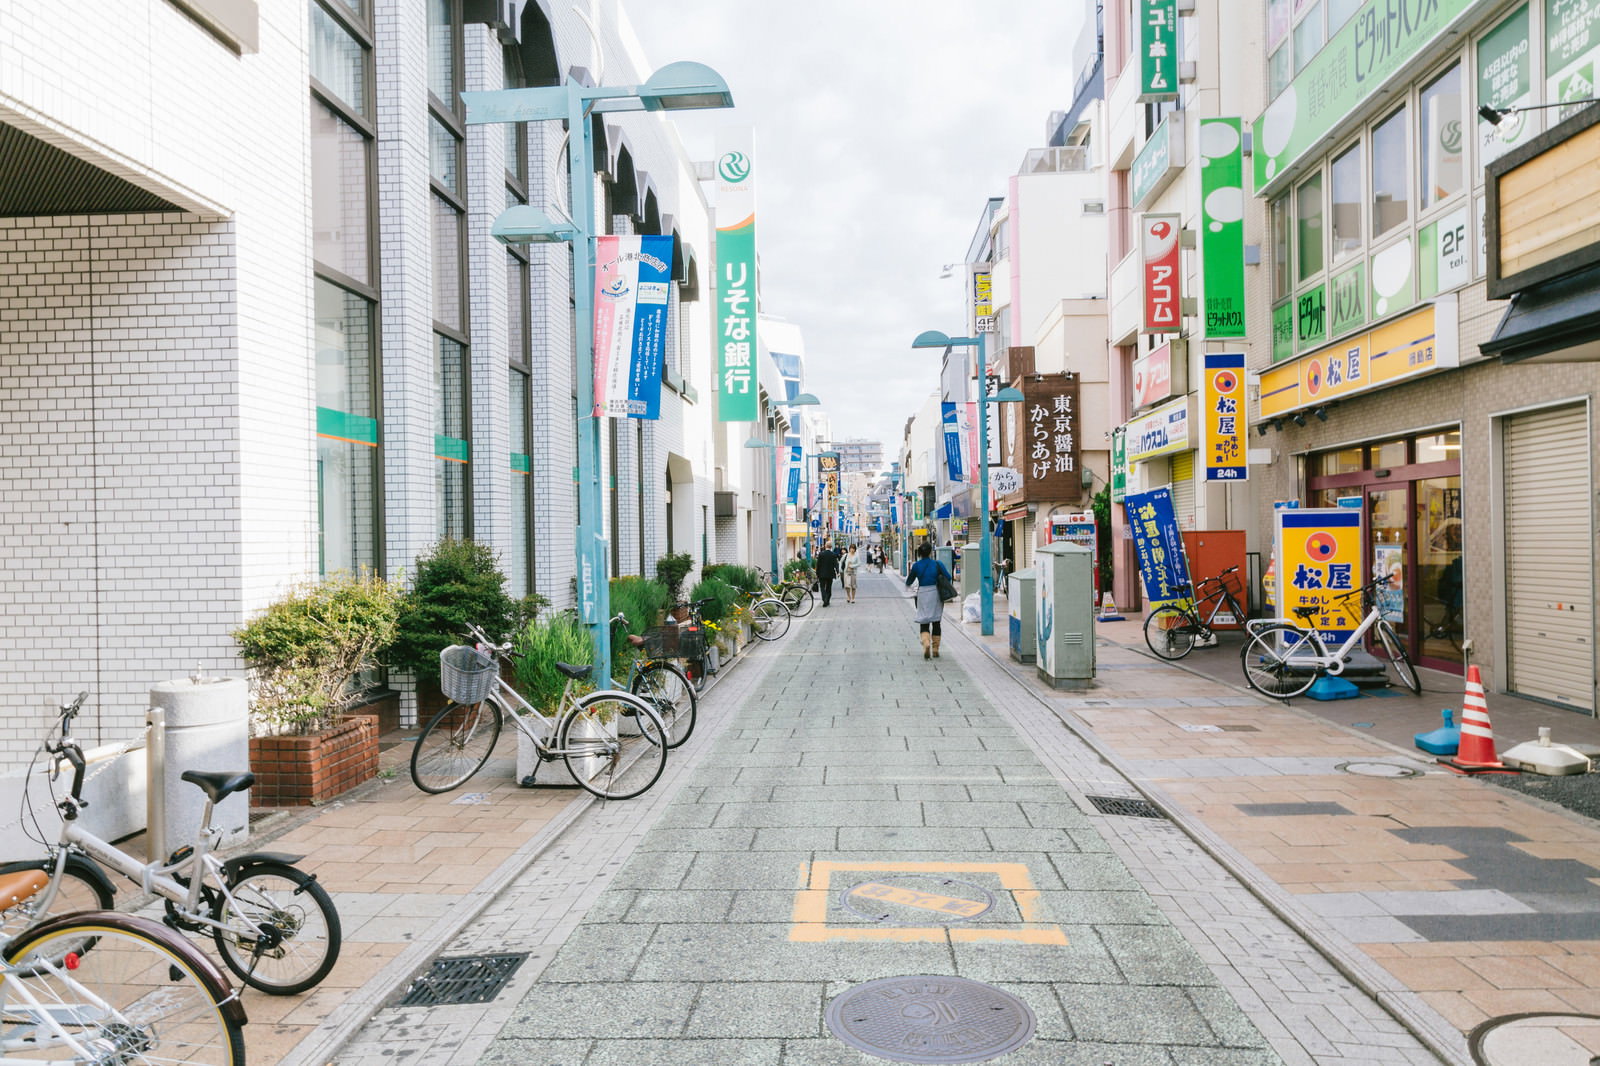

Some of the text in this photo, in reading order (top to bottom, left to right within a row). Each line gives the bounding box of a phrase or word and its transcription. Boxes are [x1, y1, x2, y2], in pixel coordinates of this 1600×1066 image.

[1482, 39, 1529, 80] 45日以内の
[1442, 224, 1465, 257] 2F
[1449, 257, 1468, 270] tel.
[1152, 265, 1173, 322] アコム
[723, 261, 751, 395] りそな銀行
[1207, 311, 1243, 327] ピタットハウス
[1298, 290, 1326, 341] ピタット
[1326, 346, 1361, 387] 松屋
[1216, 396, 1237, 435] 松屋
[1030, 403, 1052, 480] からあげ
[1052, 394, 1074, 473] 東京醤油
[1140, 426, 1169, 453] ハウスコム
[1230, 435, 1239, 458] 牛めし
[1215, 443, 1224, 463] 定食
[1223, 439, 1231, 461] カレー
[994, 471, 1014, 481] から
[997, 481, 1017, 491] あげ
[1216, 468, 1238, 478] 24h
[1138, 501, 1171, 598] 松屋の朝定食
[1293, 563, 1352, 590] 松屋
[1299, 595, 1330, 606] 牛めし
[1320, 616, 1347, 627] 定食
